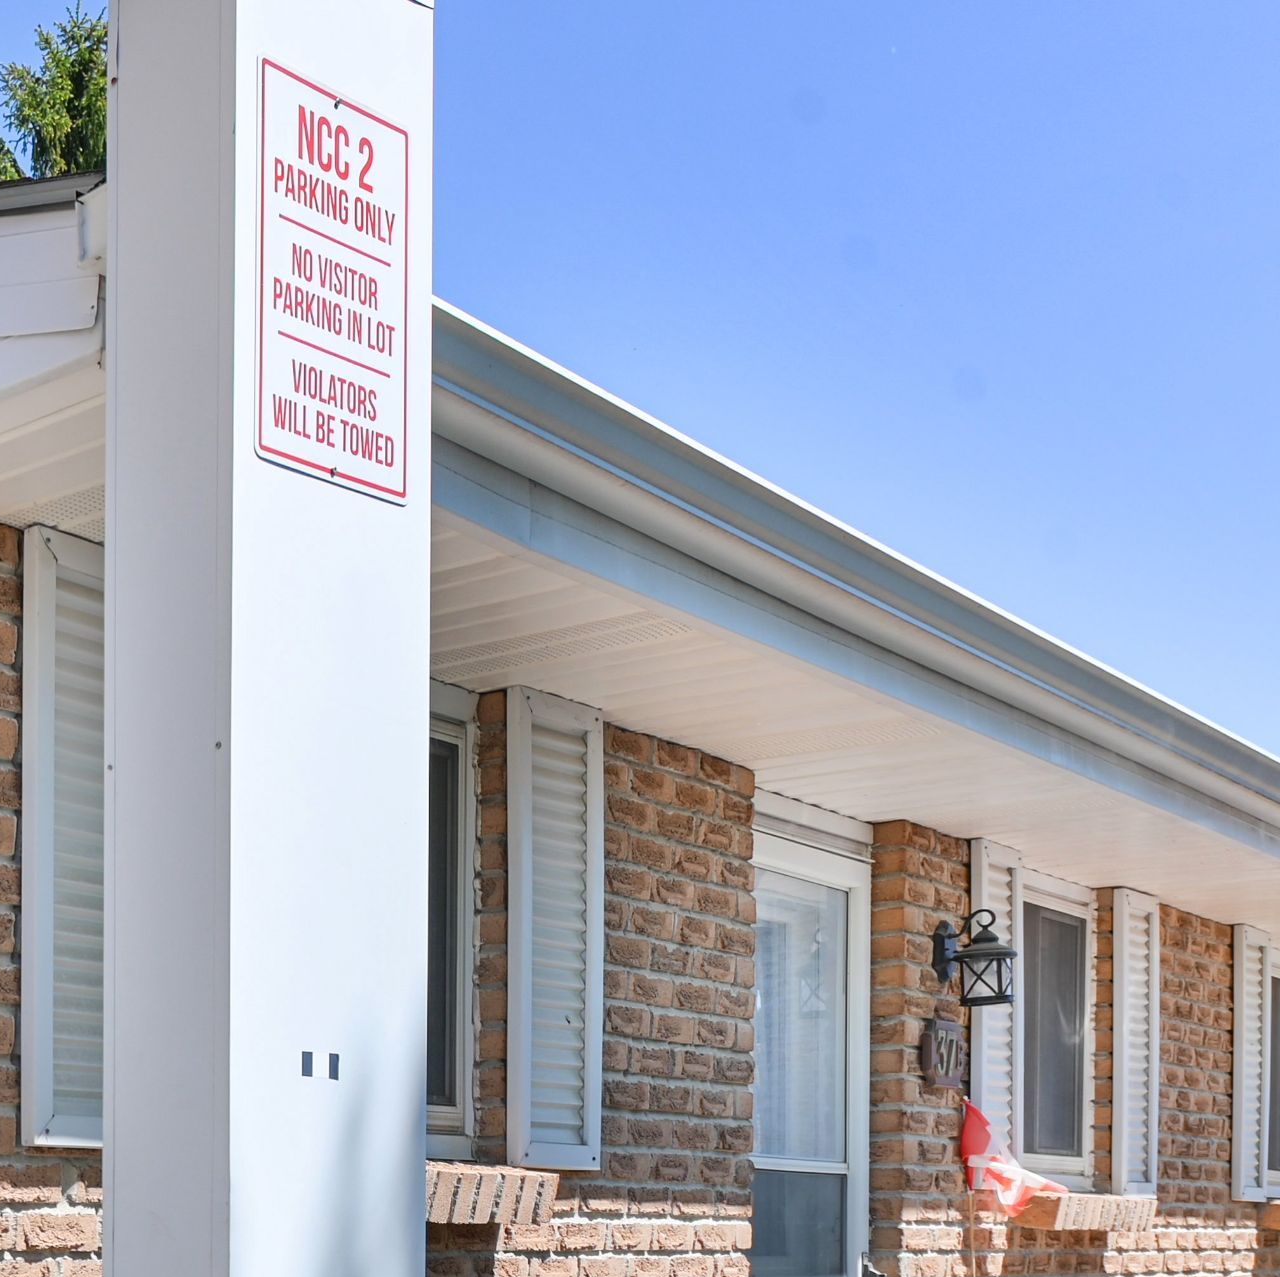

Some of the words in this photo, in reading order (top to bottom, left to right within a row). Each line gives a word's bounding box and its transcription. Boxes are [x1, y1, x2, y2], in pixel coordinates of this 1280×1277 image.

[297, 104, 351, 182] NCC
[358, 136, 375, 194] 2
[274, 157, 349, 225] PARKING
[354, 196, 396, 246] ONLY
[292, 243, 313, 283] NO
[318, 254, 378, 311] VISITOR
[273, 277, 343, 337] PARKING
[347, 308, 363, 345] IN
[367, 317, 396, 357] LOT
[292, 359, 378, 422] VIOLATORS
[272, 394, 312, 441] WILL
[315, 410, 337, 449] BE
[340, 420, 395, 468] TOWED
